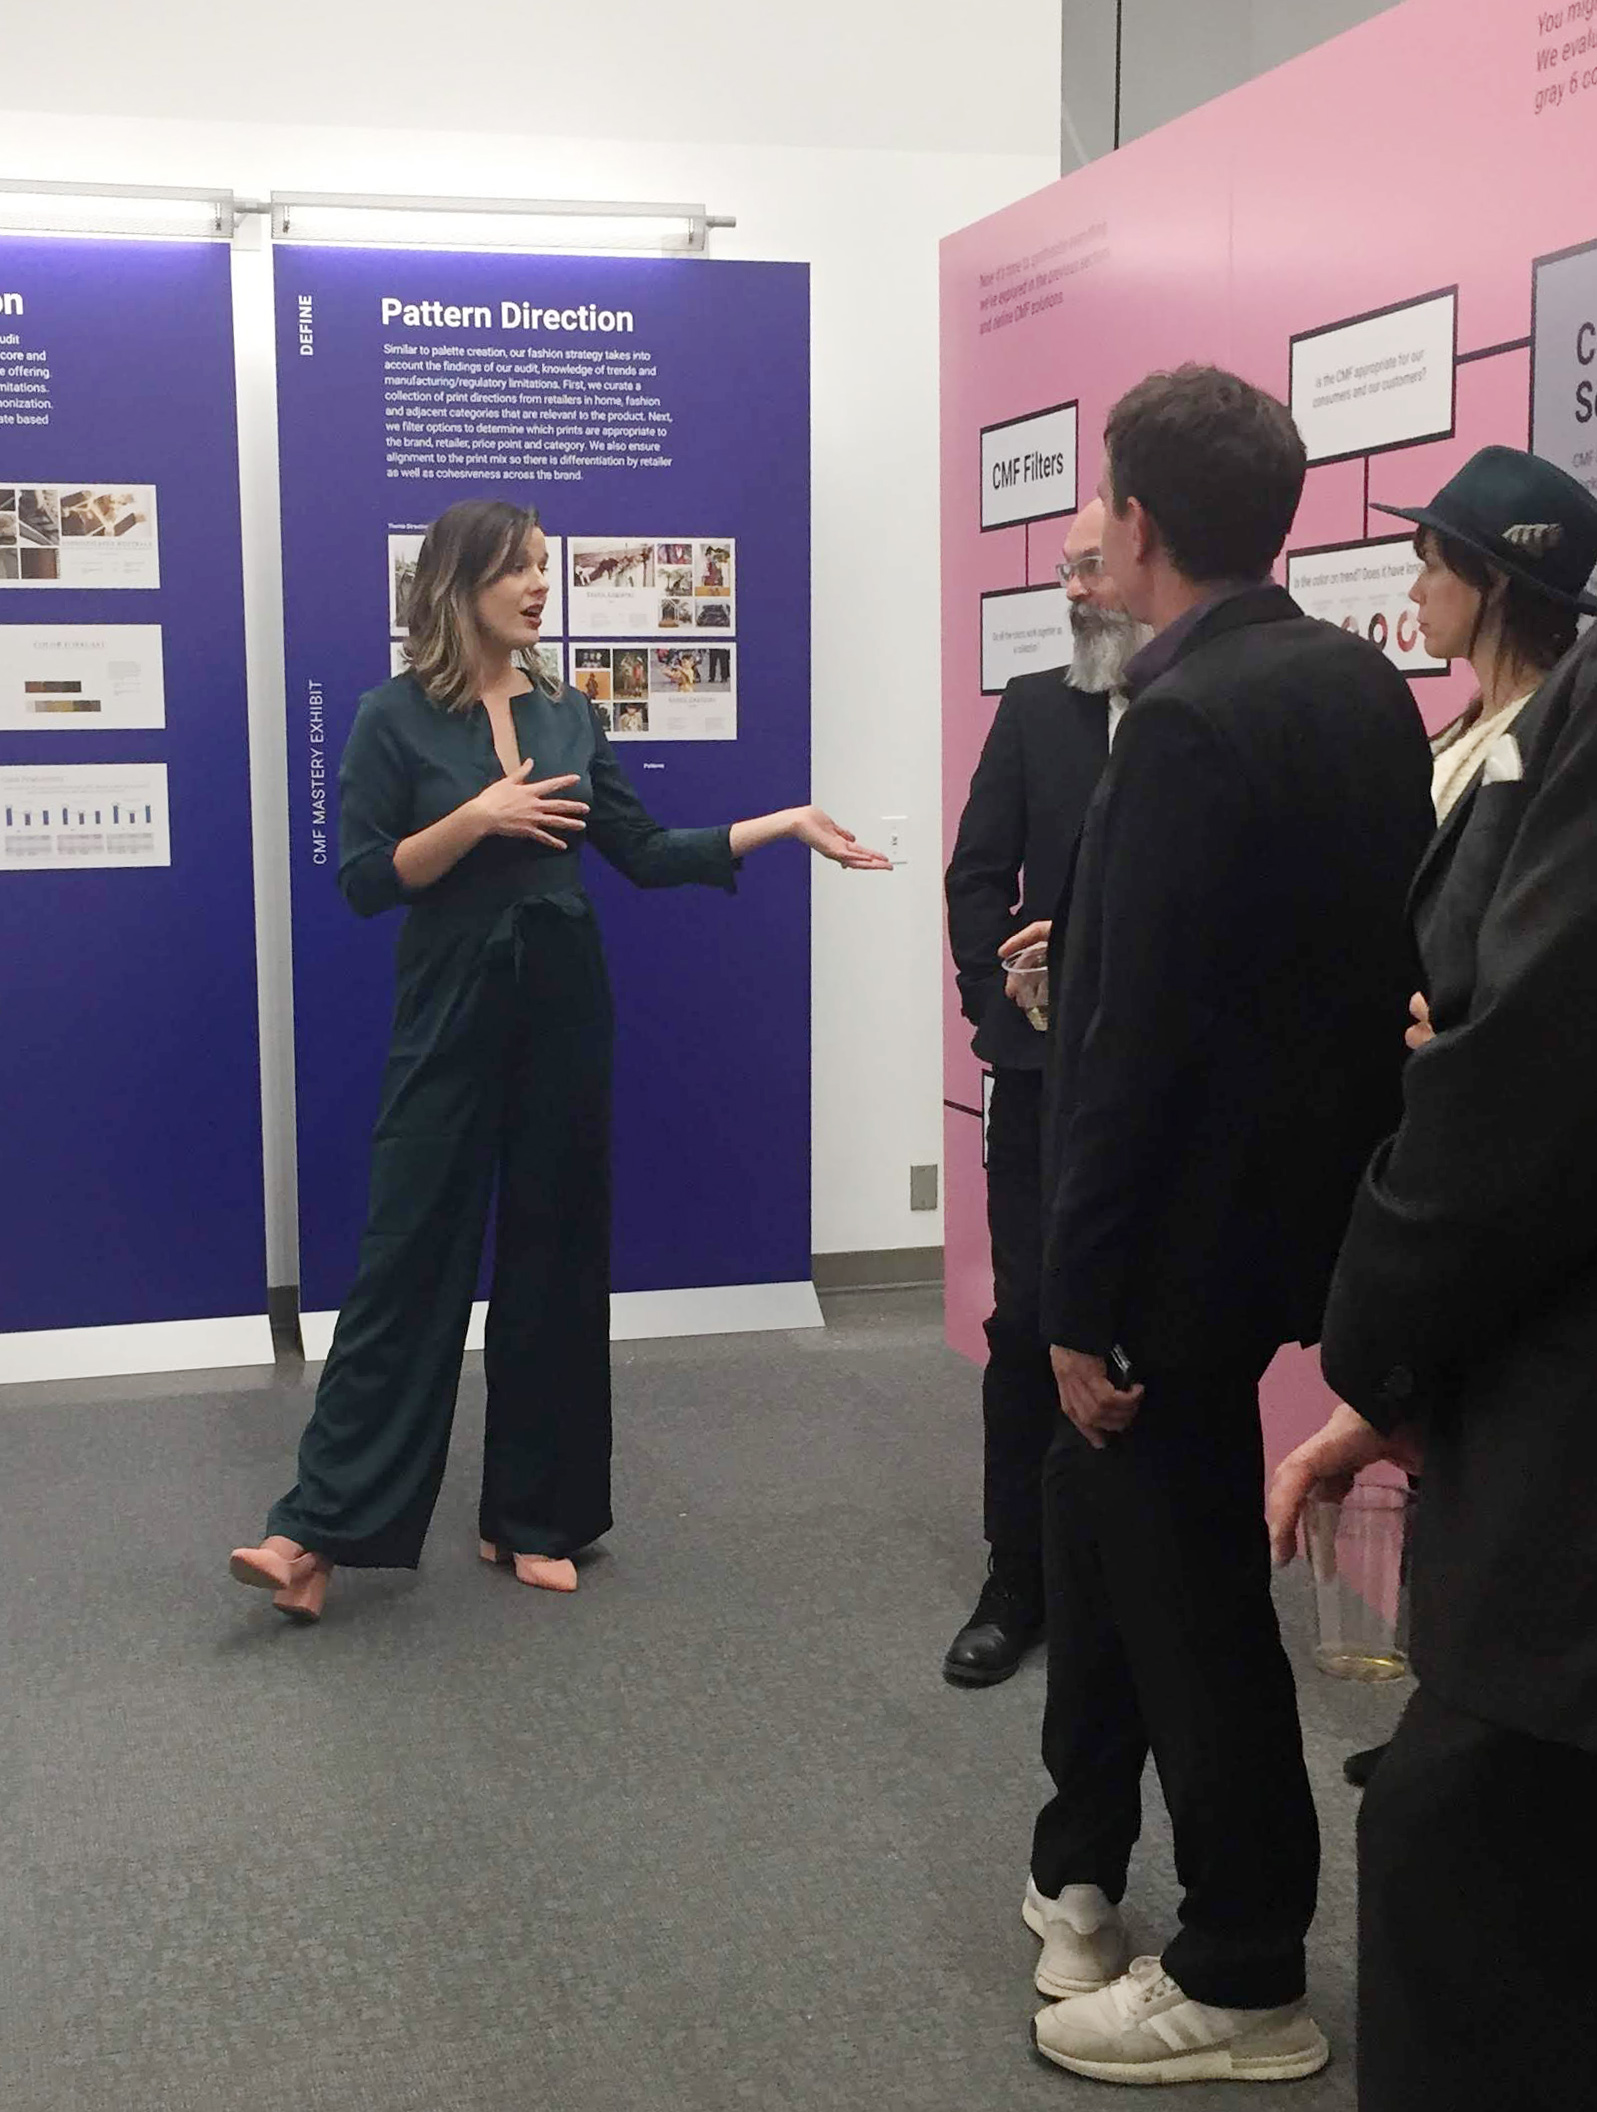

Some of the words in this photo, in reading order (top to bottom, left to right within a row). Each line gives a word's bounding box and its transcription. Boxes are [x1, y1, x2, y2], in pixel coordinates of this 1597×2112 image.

[1537, 11, 1563, 36] You
[1537, 47, 1558, 71] We
[1534, 84, 1565, 114] gray
[1569, 71, 1578, 94] 6
[381, 297, 492, 328] Pattern
[501, 301, 634, 332] Direction
[298, 295, 313, 356] DEFINE
[26, 350, 47, 361] and
[384, 343, 418, 355] Similar
[419, 344, 429, 355] to
[432, 344, 464, 358] palette
[466, 345, 507, 358] creation,
[510, 349, 525, 357] our
[528, 347, 563, 358] fashion
[565, 348, 603, 362] strategy
[605, 349, 631, 360] takes
[633, 350, 650, 361] into
[384, 359, 424, 371] account
[426, 360, 441, 371] the
[443, 361, 482, 374] findings
[484, 362, 493, 372] of
[496, 364, 512, 373] our
[542, 363, 593, 377] knowledge
[594, 364, 605, 375] of
[638, 365, 657, 376] and
[385, 374, 507, 390] manufacturing/regulatory
[588, 381, 601, 390] we
[603, 379, 633, 390] curate
[635, 382, 641, 391] a
[385, 390, 431, 402] collection
[434, 391, 444, 402] of
[446, 391, 468, 405] print
[470, 392, 517, 403] directions
[519, 393, 542, 404] from
[543, 393, 582, 405] retailers
[584, 394, 593, 405] in
[626, 395, 661, 406] fashion
[16, 413, 49, 425] based
[385, 406, 404, 417] and
[405, 406, 448, 420] adjacent
[449, 407, 499, 421] categories
[502, 408, 520, 419] that
[522, 410, 538, 419] are
[540, 408, 577, 420] relevant
[579, 409, 589, 420] to
[590, 409, 606, 420] the
[386, 423, 400, 432] we
[402, 421, 424, 432] filter
[426, 422, 462, 435] options
[464, 422, 474, 433] to
[476, 423, 524, 434] determine
[526, 424, 554, 435] which
[556, 424, 583, 437] prints
[585, 427, 600, 435] are
[602, 425, 655, 439] appropriate
[657, 426, 667, 437] to
[386, 436, 401, 447] the
[472, 438, 496, 451] price
[498, 438, 522, 451] point
[524, 438, 542, 449] and
[589, 440, 605, 450] We
[606, 440, 626, 451] also
[628, 443, 661, 451] ensure
[386, 452, 434, 465] alignment
[436, 452, 446, 463] to
[449, 453, 464, 463] the
[466, 453, 488, 466] print
[489, 453, 507, 464] mix
[509, 456, 521, 464] so
[523, 454, 548, 465] there
[549, 454, 557, 465] is
[559, 454, 625, 466] differentiation
[626, 455, 638, 468] by
[640, 455, 672, 466] retailer
[387, 469, 398, 477] as
[401, 467, 420, 478] well
[422, 469, 434, 478] as
[503, 471, 535, 479] across
[537, 469, 552, 480] the
[992, 457, 1020, 490] CMF
[1024, 451, 1064, 483] Filters
[309, 679, 325, 743] EXHIBIT
[311, 748, 326, 825] MASTERY
[312, 829, 327, 866] CMF
